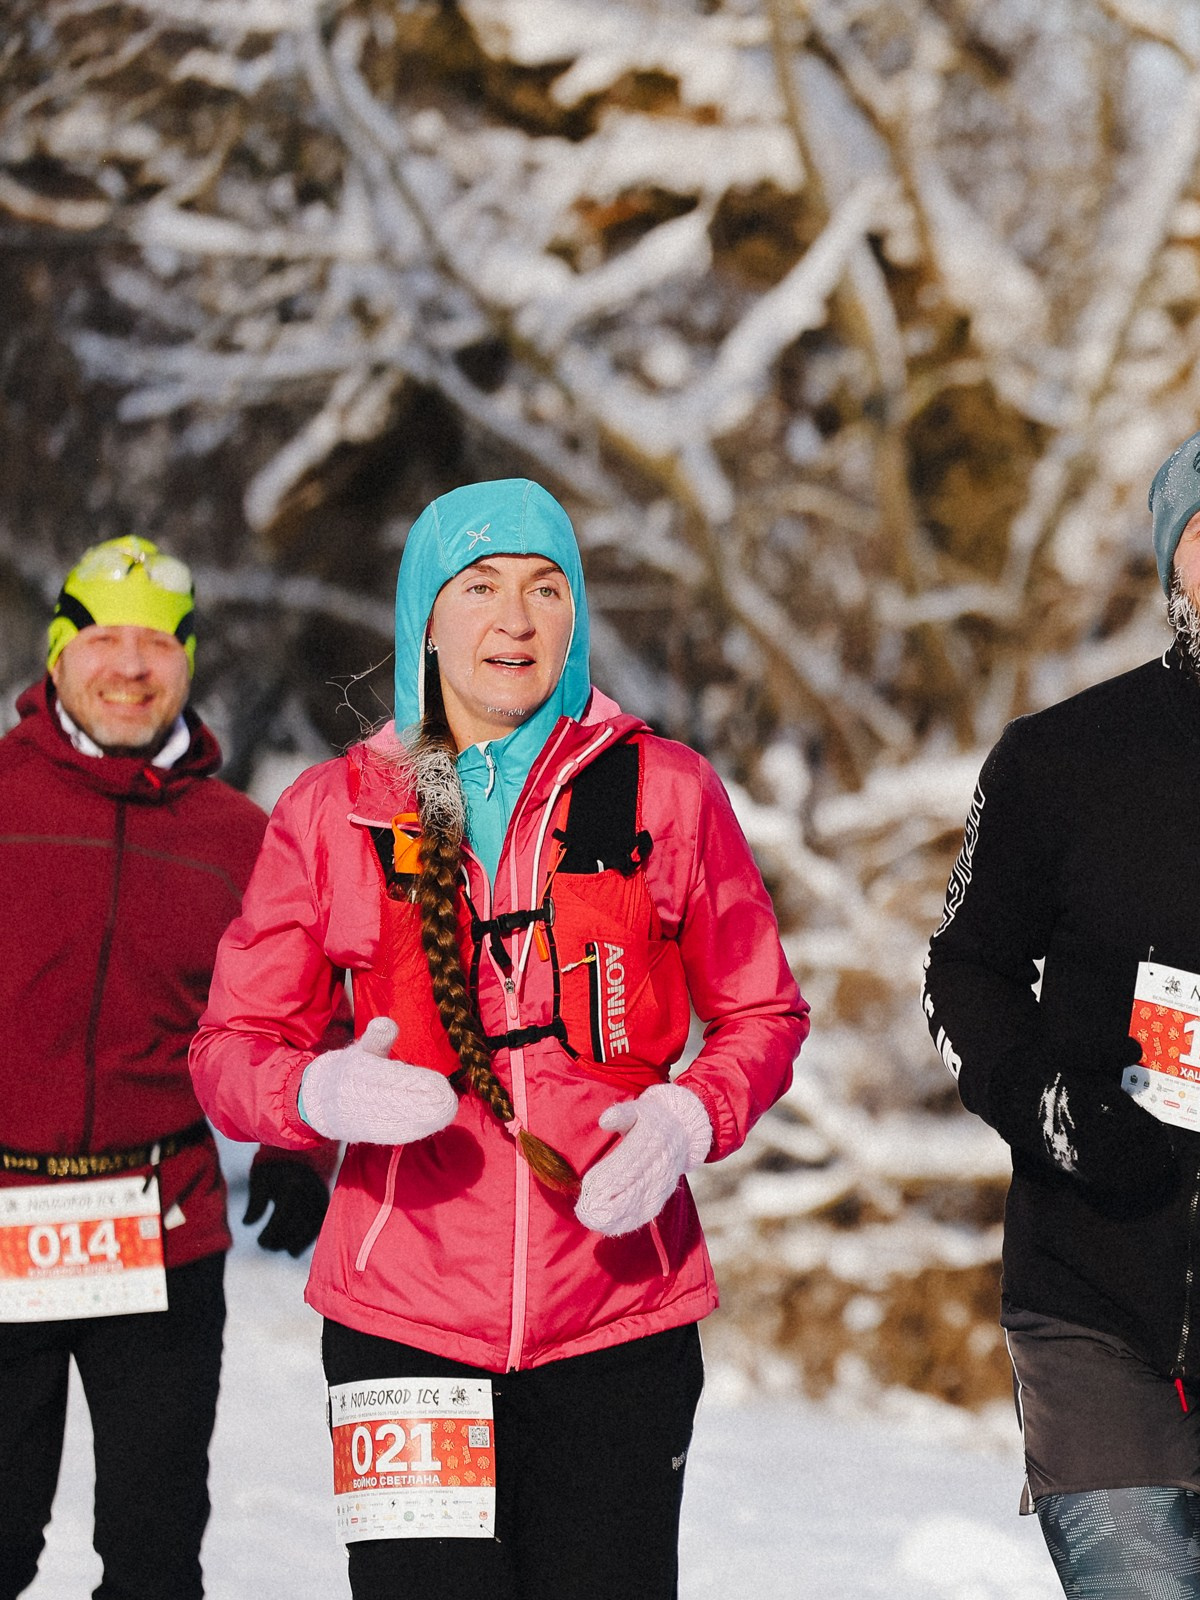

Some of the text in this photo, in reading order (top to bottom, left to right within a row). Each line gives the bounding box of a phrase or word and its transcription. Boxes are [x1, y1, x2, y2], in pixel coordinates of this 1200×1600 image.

[602, 941, 630, 1058] AONIJIE
[28, 1220, 121, 1268] 014
[350, 1388, 440, 1408] NOVGOROD ICE
[351, 1422, 442, 1475] 021
[379, 1474, 441, 1486] СВЕТЛАНА
